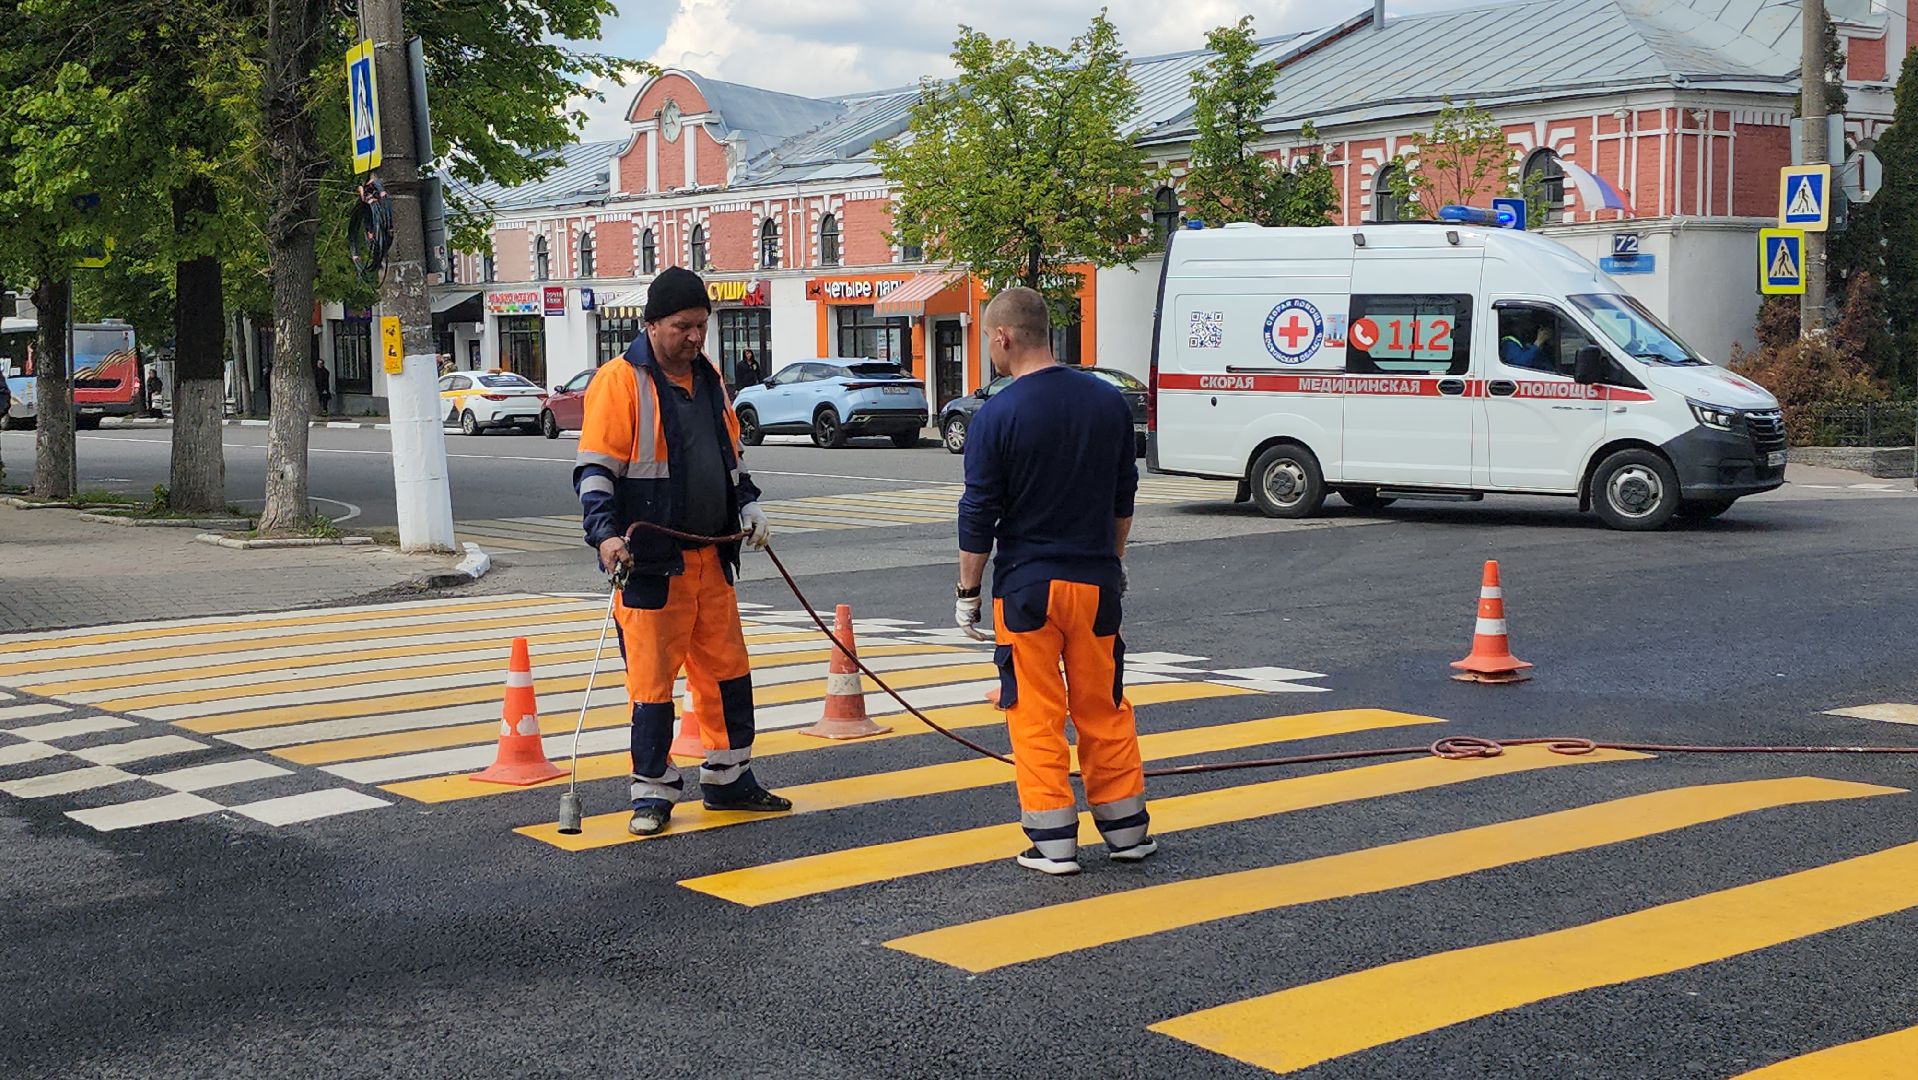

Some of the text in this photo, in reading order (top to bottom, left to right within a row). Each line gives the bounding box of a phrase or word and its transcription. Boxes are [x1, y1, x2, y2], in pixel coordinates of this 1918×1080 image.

[1615, 235, 1638, 251] 72
[1266, 299, 1322, 327] СКОРАЯ ПОМОЩЬ
[1387, 319, 1451, 351] 112
[1199, 375, 1599, 399] СКОРАЯ МЕДИЦИНСКАЯ ПОМОЩЬ
